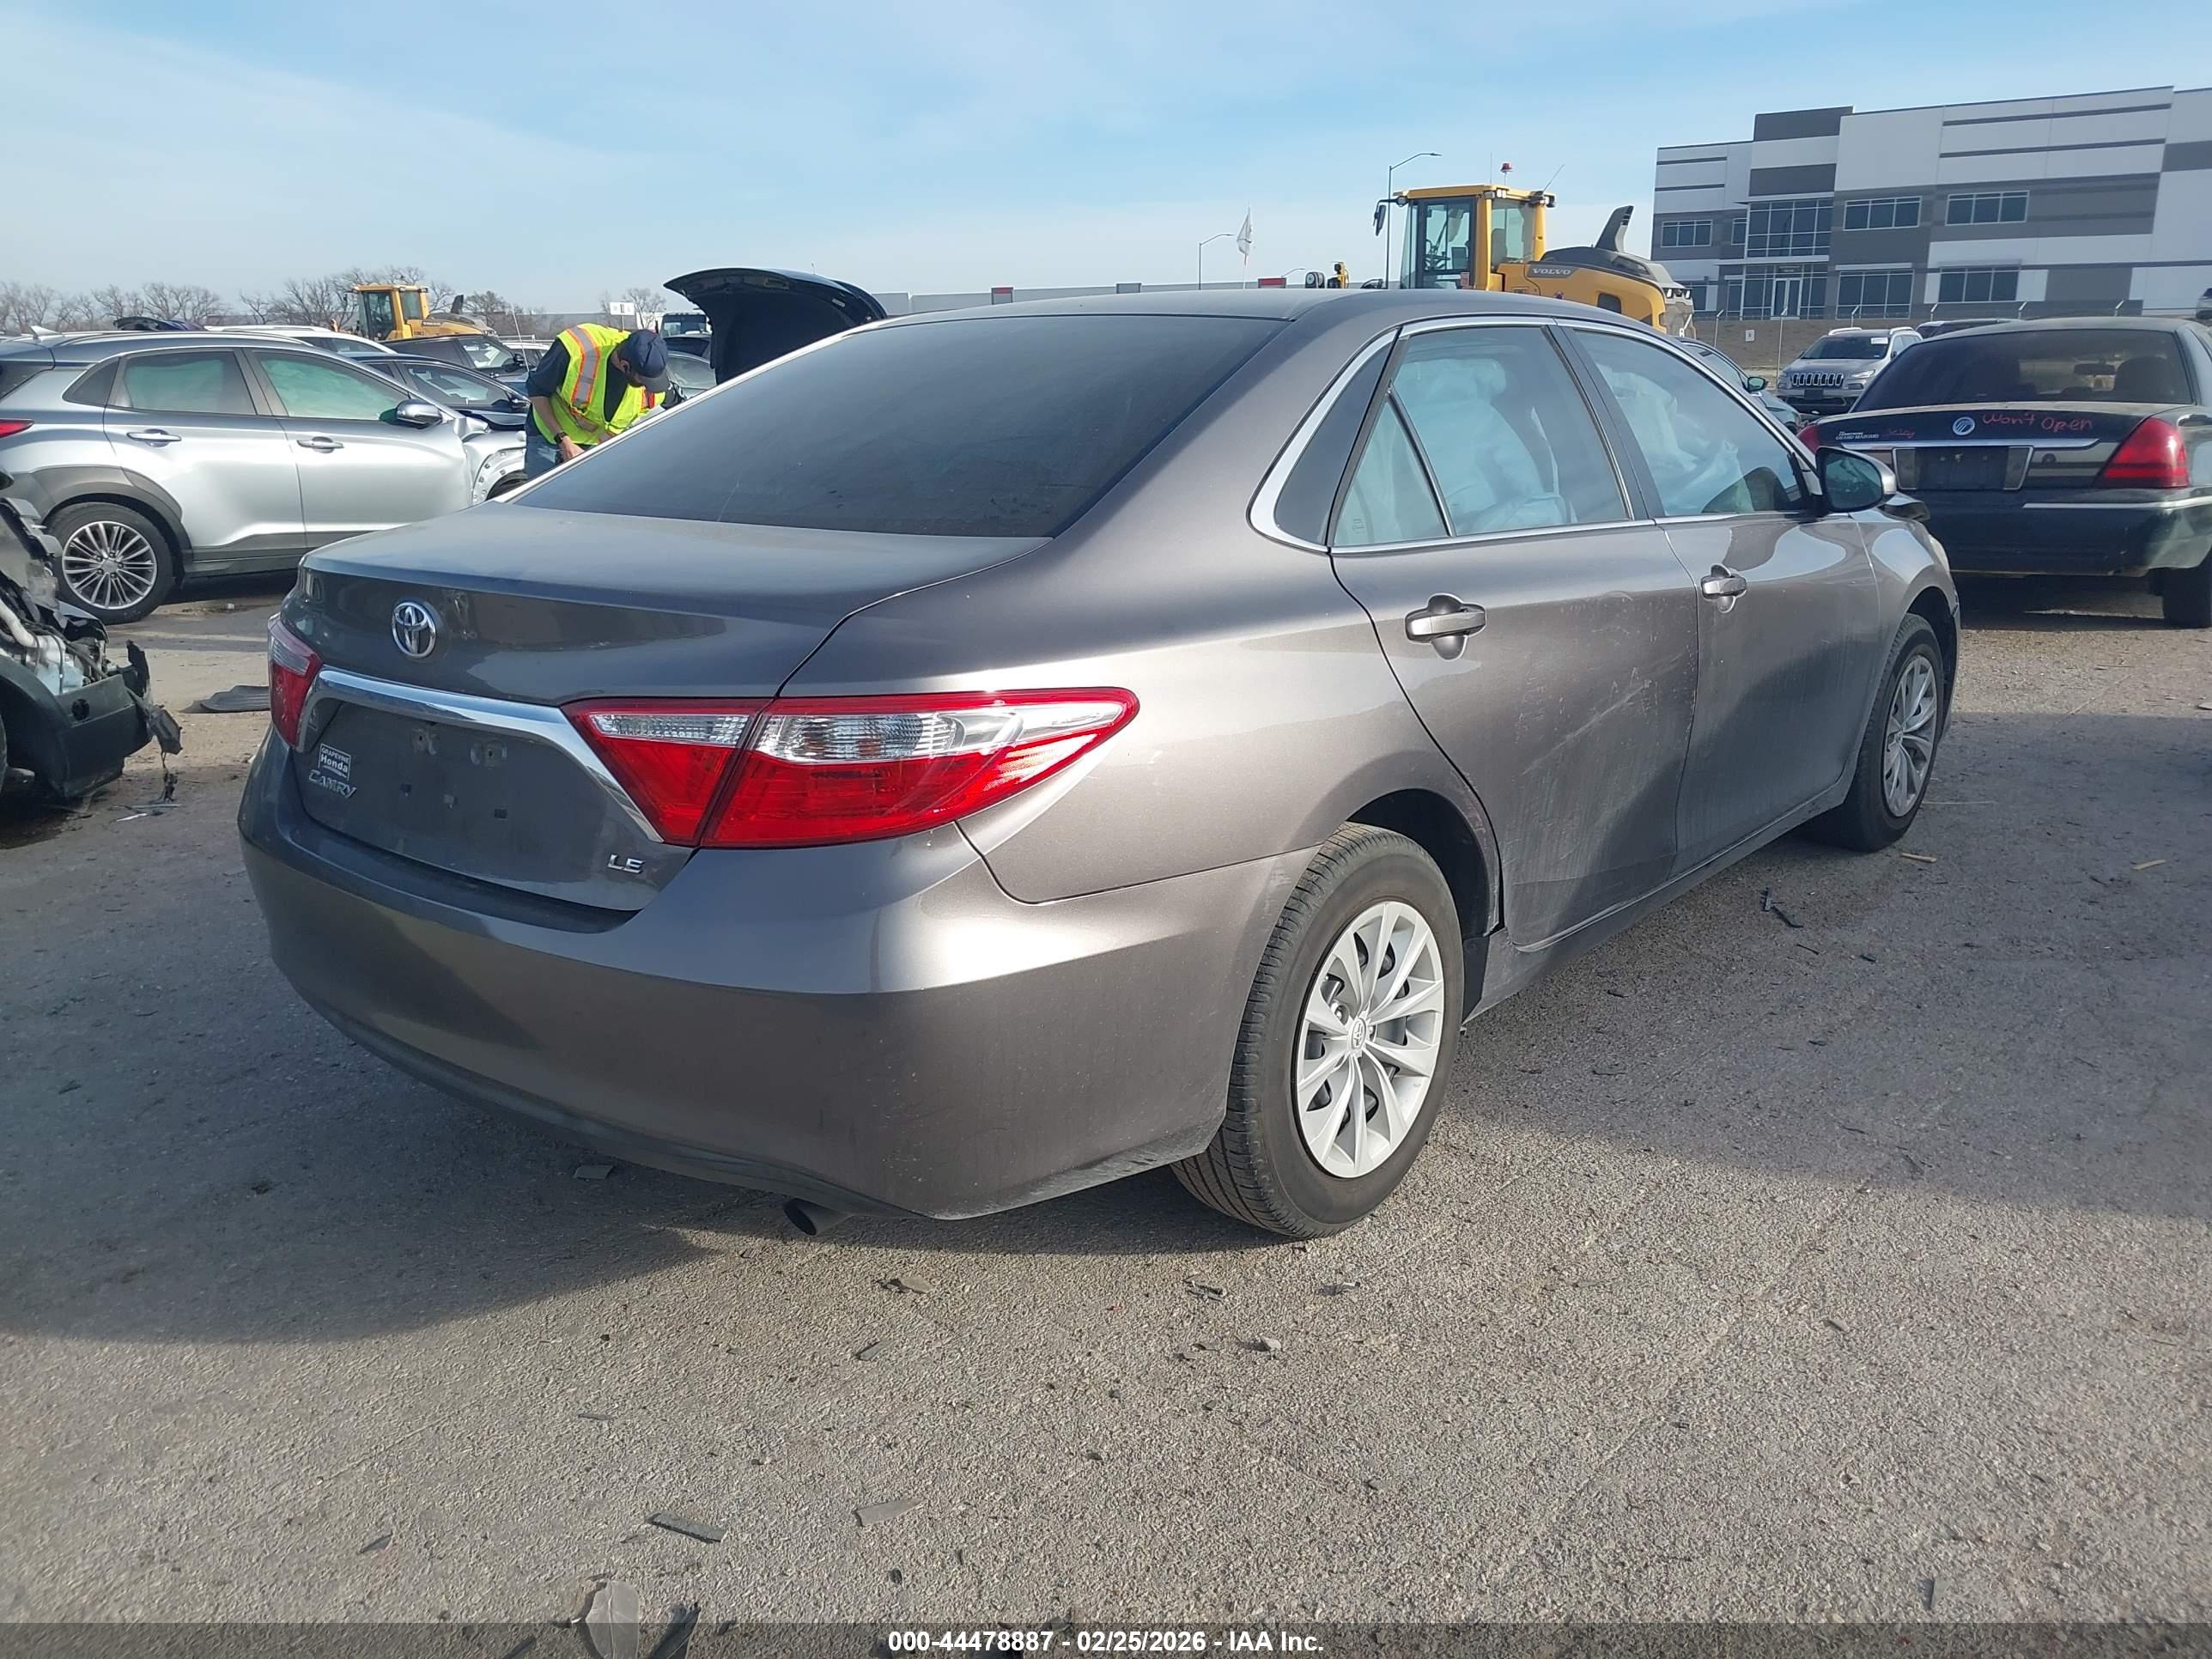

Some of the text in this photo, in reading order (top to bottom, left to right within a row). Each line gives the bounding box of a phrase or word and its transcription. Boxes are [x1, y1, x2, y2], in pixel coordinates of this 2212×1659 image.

[320, 754, 349, 773] Honda
[308, 769, 357, 799] CAMRY
[608, 854, 646, 873] LE
